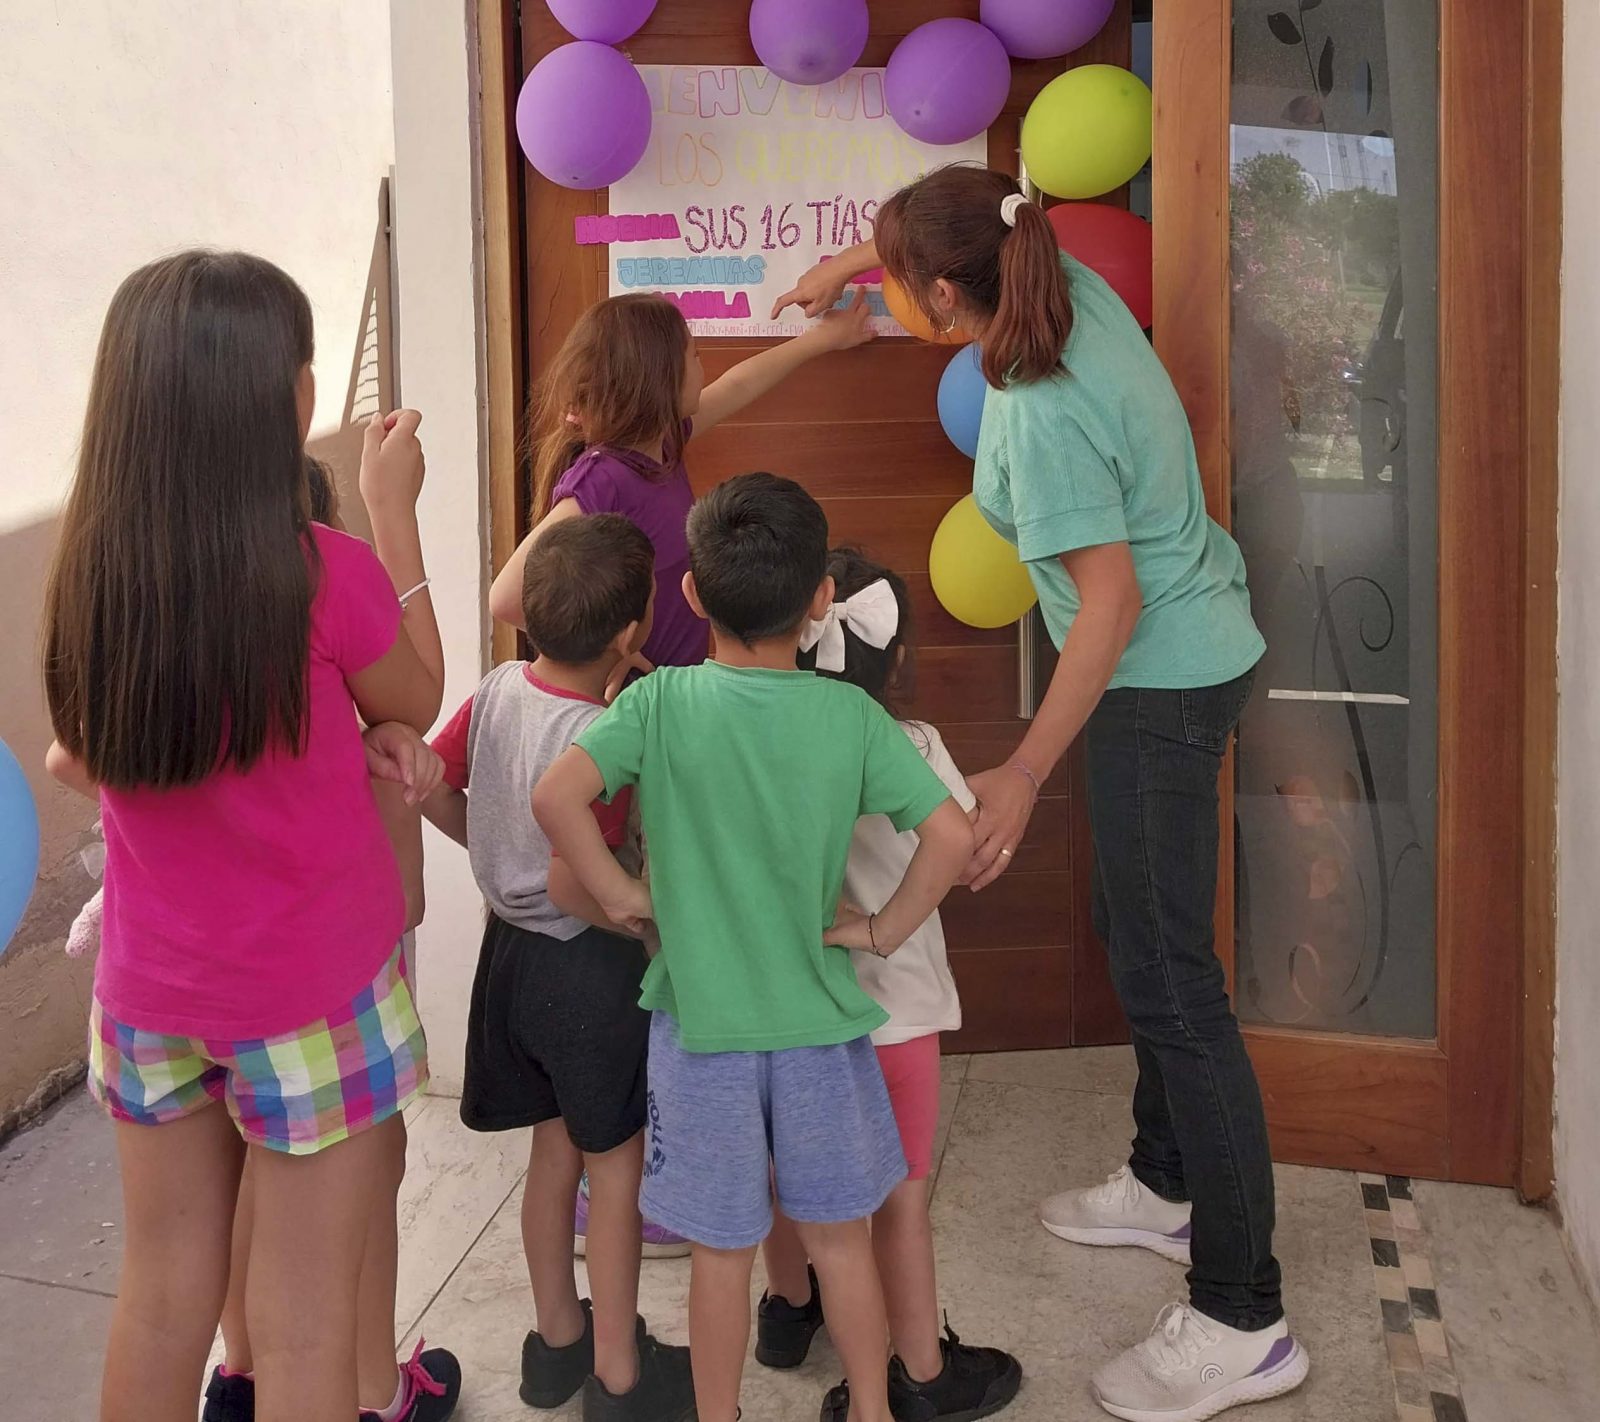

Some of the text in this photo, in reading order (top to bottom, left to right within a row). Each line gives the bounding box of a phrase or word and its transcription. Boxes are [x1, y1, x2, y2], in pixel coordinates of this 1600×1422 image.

[640, 68, 890, 120] IENVENI
[656, 130, 926, 187] LOS QUEREMOS
[684, 204, 747, 253] SUS
[760, 202, 800, 250] 16
[617, 254, 766, 287] JEREMIAS
[653, 290, 751, 319] MILA
